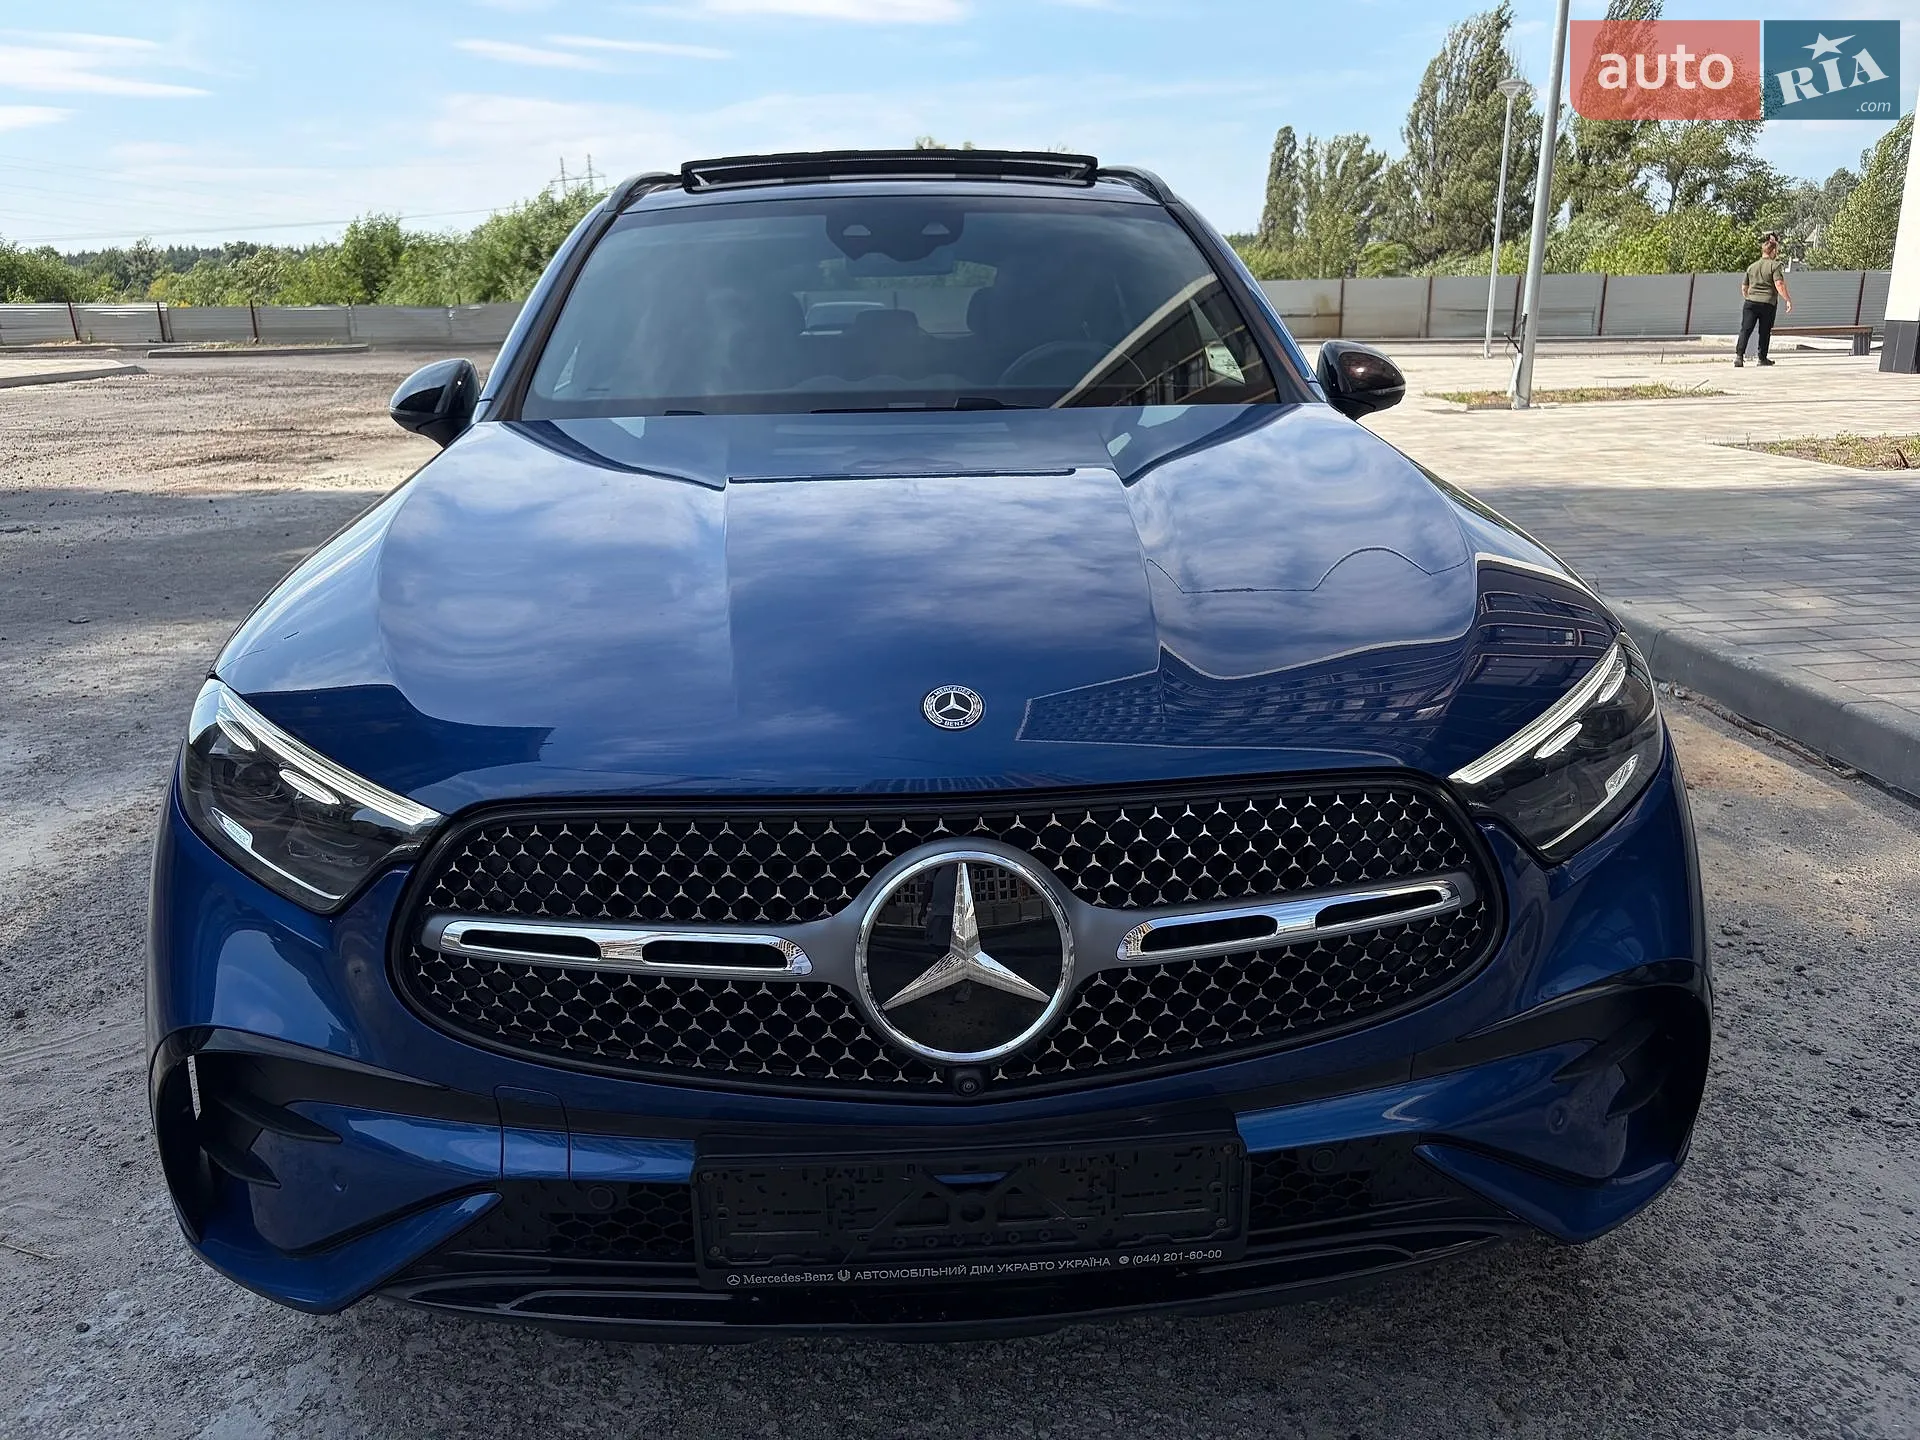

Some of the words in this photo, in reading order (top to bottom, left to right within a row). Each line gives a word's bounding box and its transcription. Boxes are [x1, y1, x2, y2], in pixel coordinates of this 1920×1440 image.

[743, 1272, 834, 1284] Mercedes-Benz
[854, 1265, 967, 1280] АВТОМОБІЛЬНИЙ
[970, 1264, 994, 1275] ДІМ
[997, 1261, 1055, 1273] УКРАВТО
[1058, 1257, 1111, 1269] УКРАЇНА
[1132, 1253, 1160, 1266] (044)
[1163, 1249, 1222, 1262] 201-60-00
